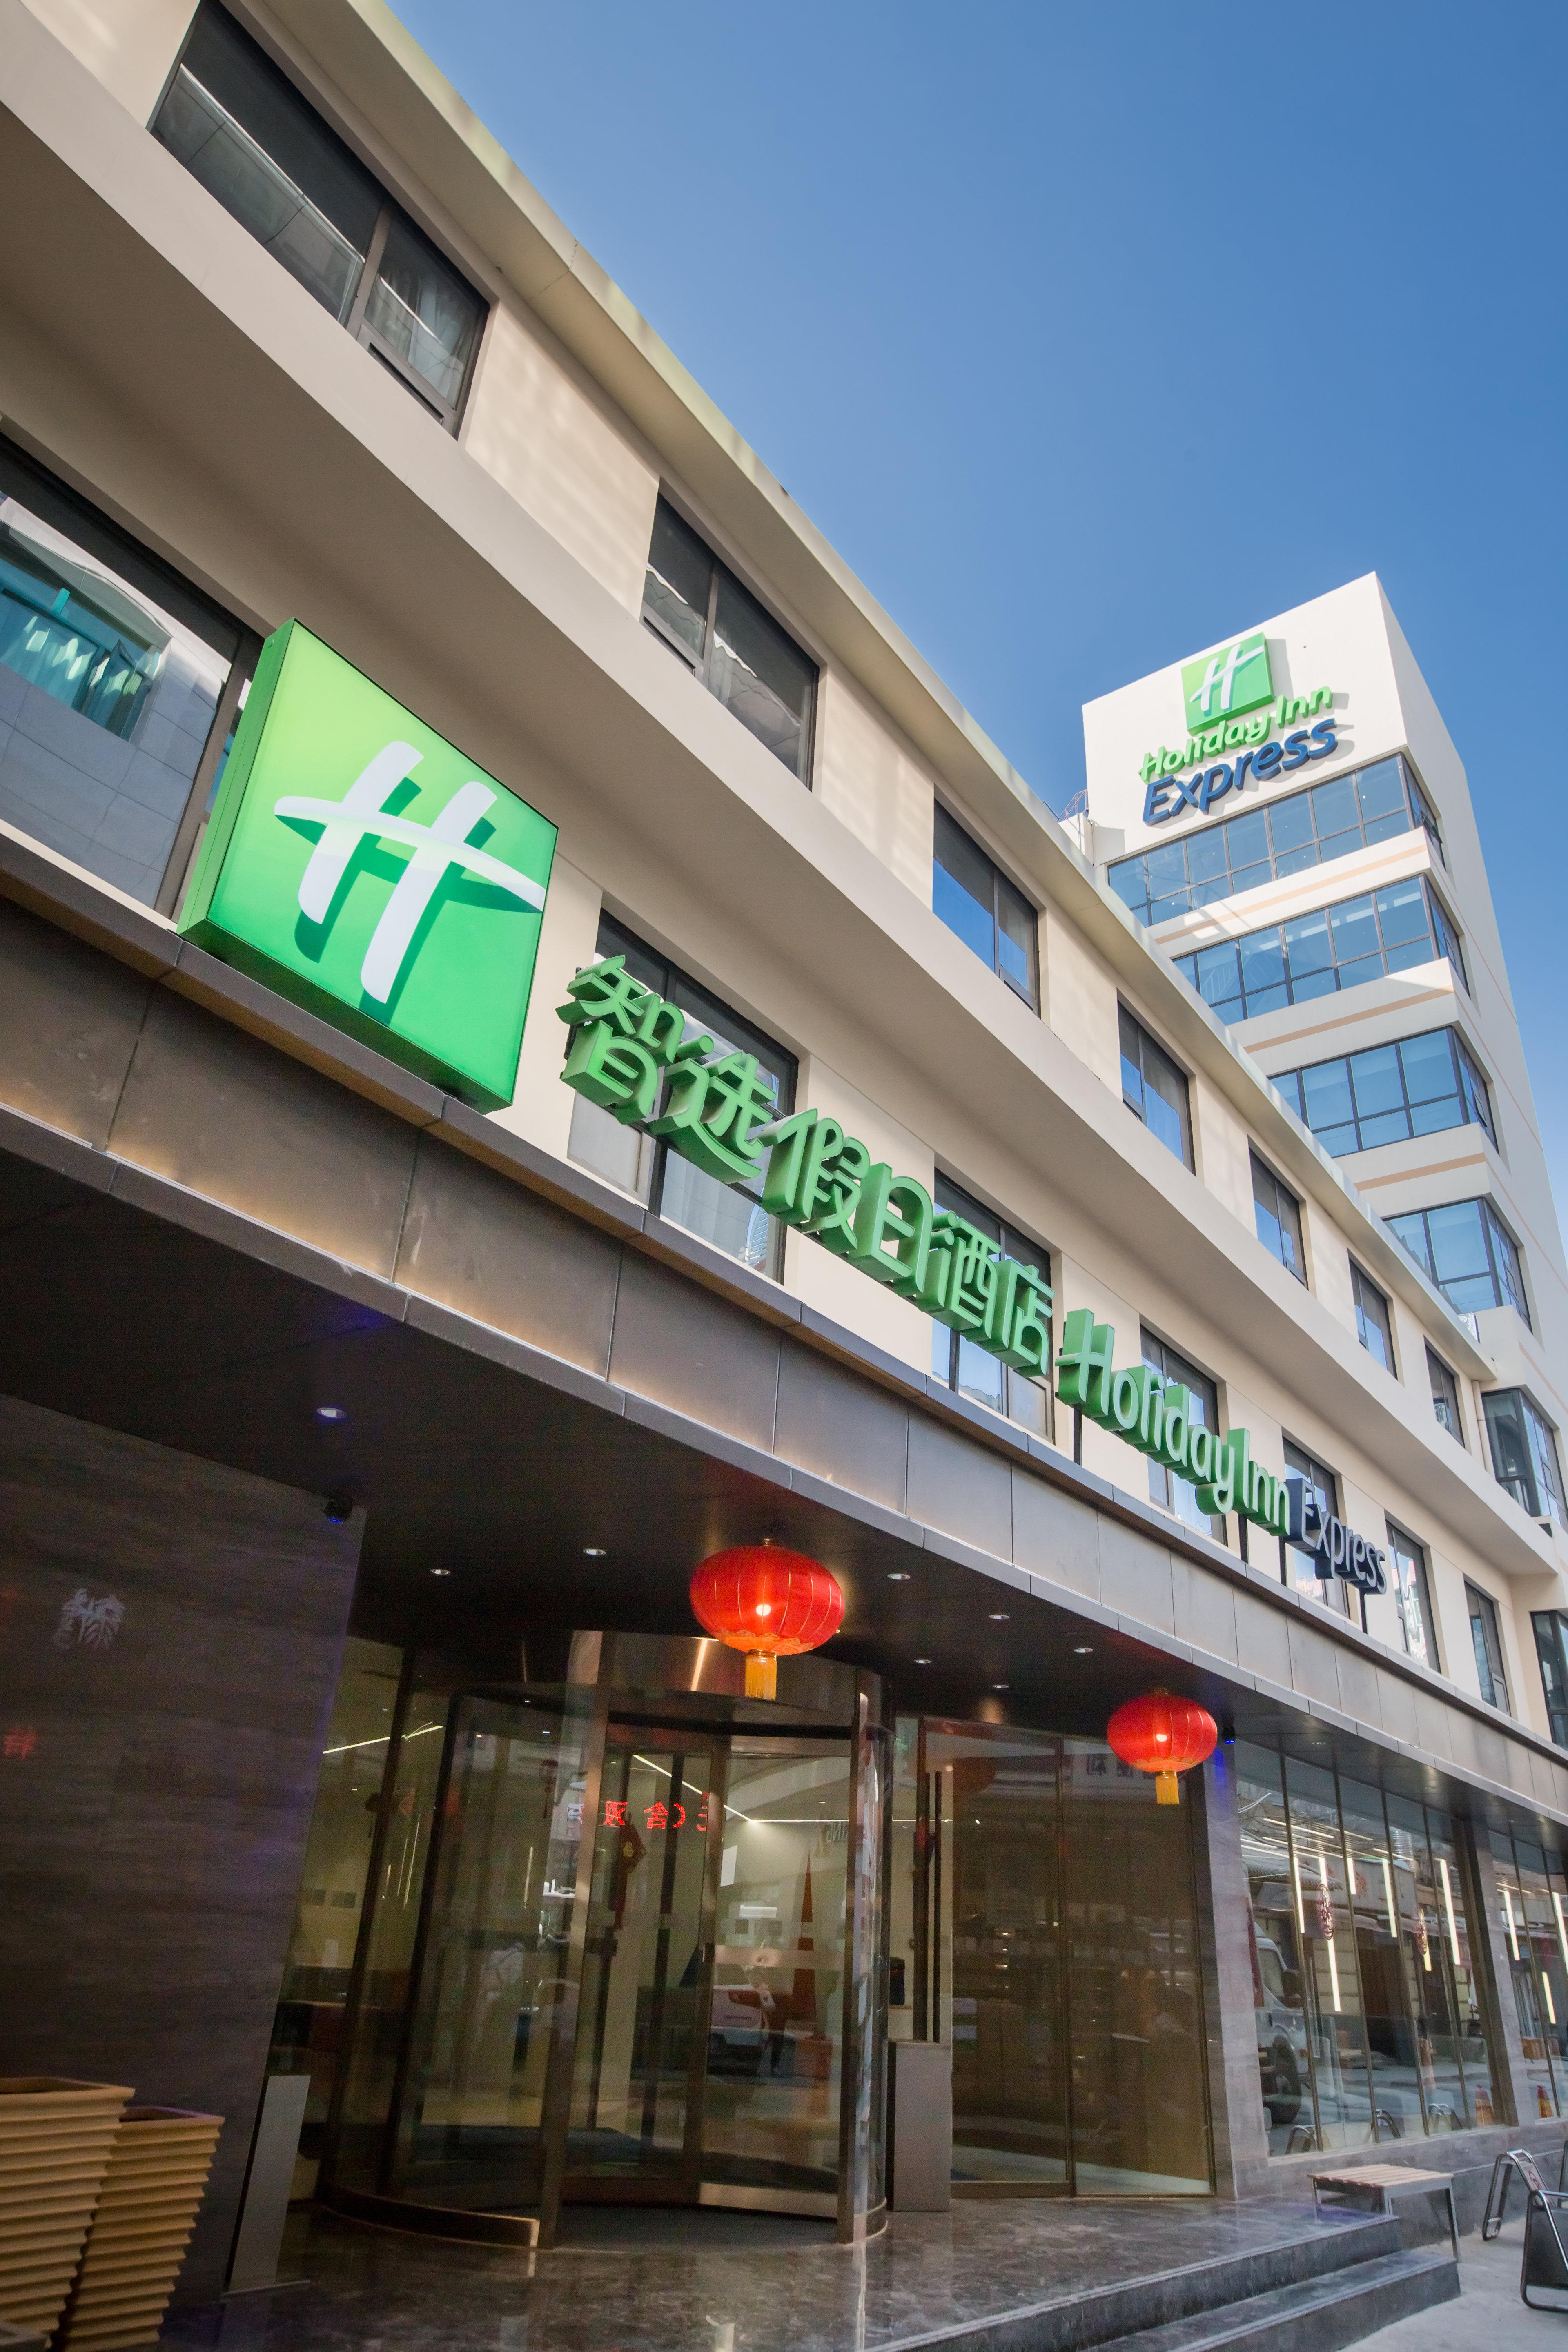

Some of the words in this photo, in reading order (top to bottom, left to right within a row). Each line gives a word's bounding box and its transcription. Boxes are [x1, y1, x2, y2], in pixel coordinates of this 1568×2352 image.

[1139, 712, 1271, 784] Holiday
[1275, 686, 1333, 728] Inn
[1142, 718, 1338, 826] Express
[555, 955, 1056, 1378] 智选假日酒店
[1055, 1308, 1235, 1515] Holiday
[1227, 1428, 1291, 1537] Inn
[1285, 1478, 1387, 1595] Express
